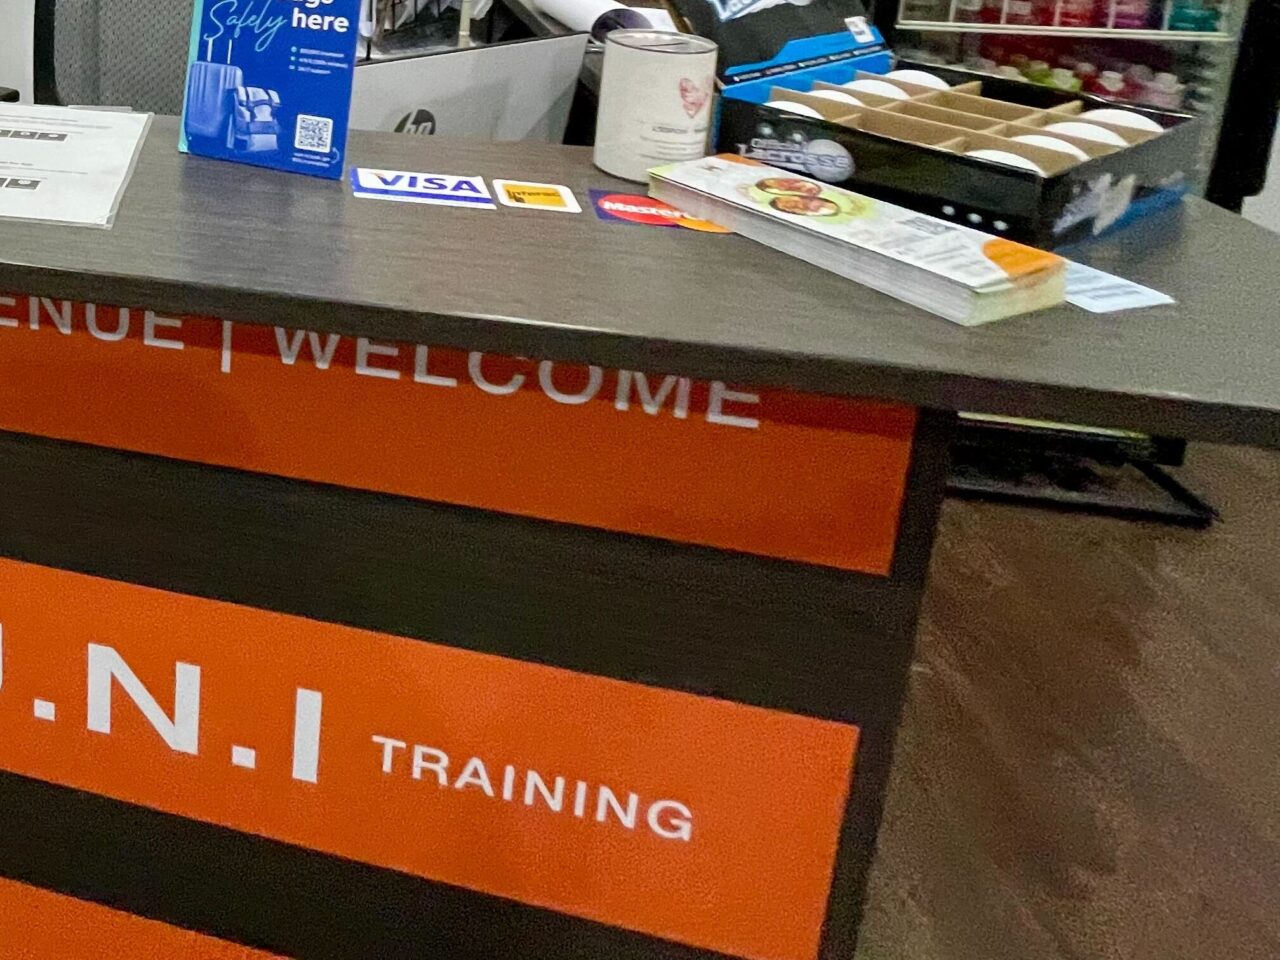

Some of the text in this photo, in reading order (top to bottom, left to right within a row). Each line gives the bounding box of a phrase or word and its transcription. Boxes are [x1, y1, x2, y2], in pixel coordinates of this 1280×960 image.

[292, 8, 350, 33] here
[373, 173, 482, 195] VISA
[274, 326, 760, 428] WELCOME
[371, 734, 694, 841] TRAINING
